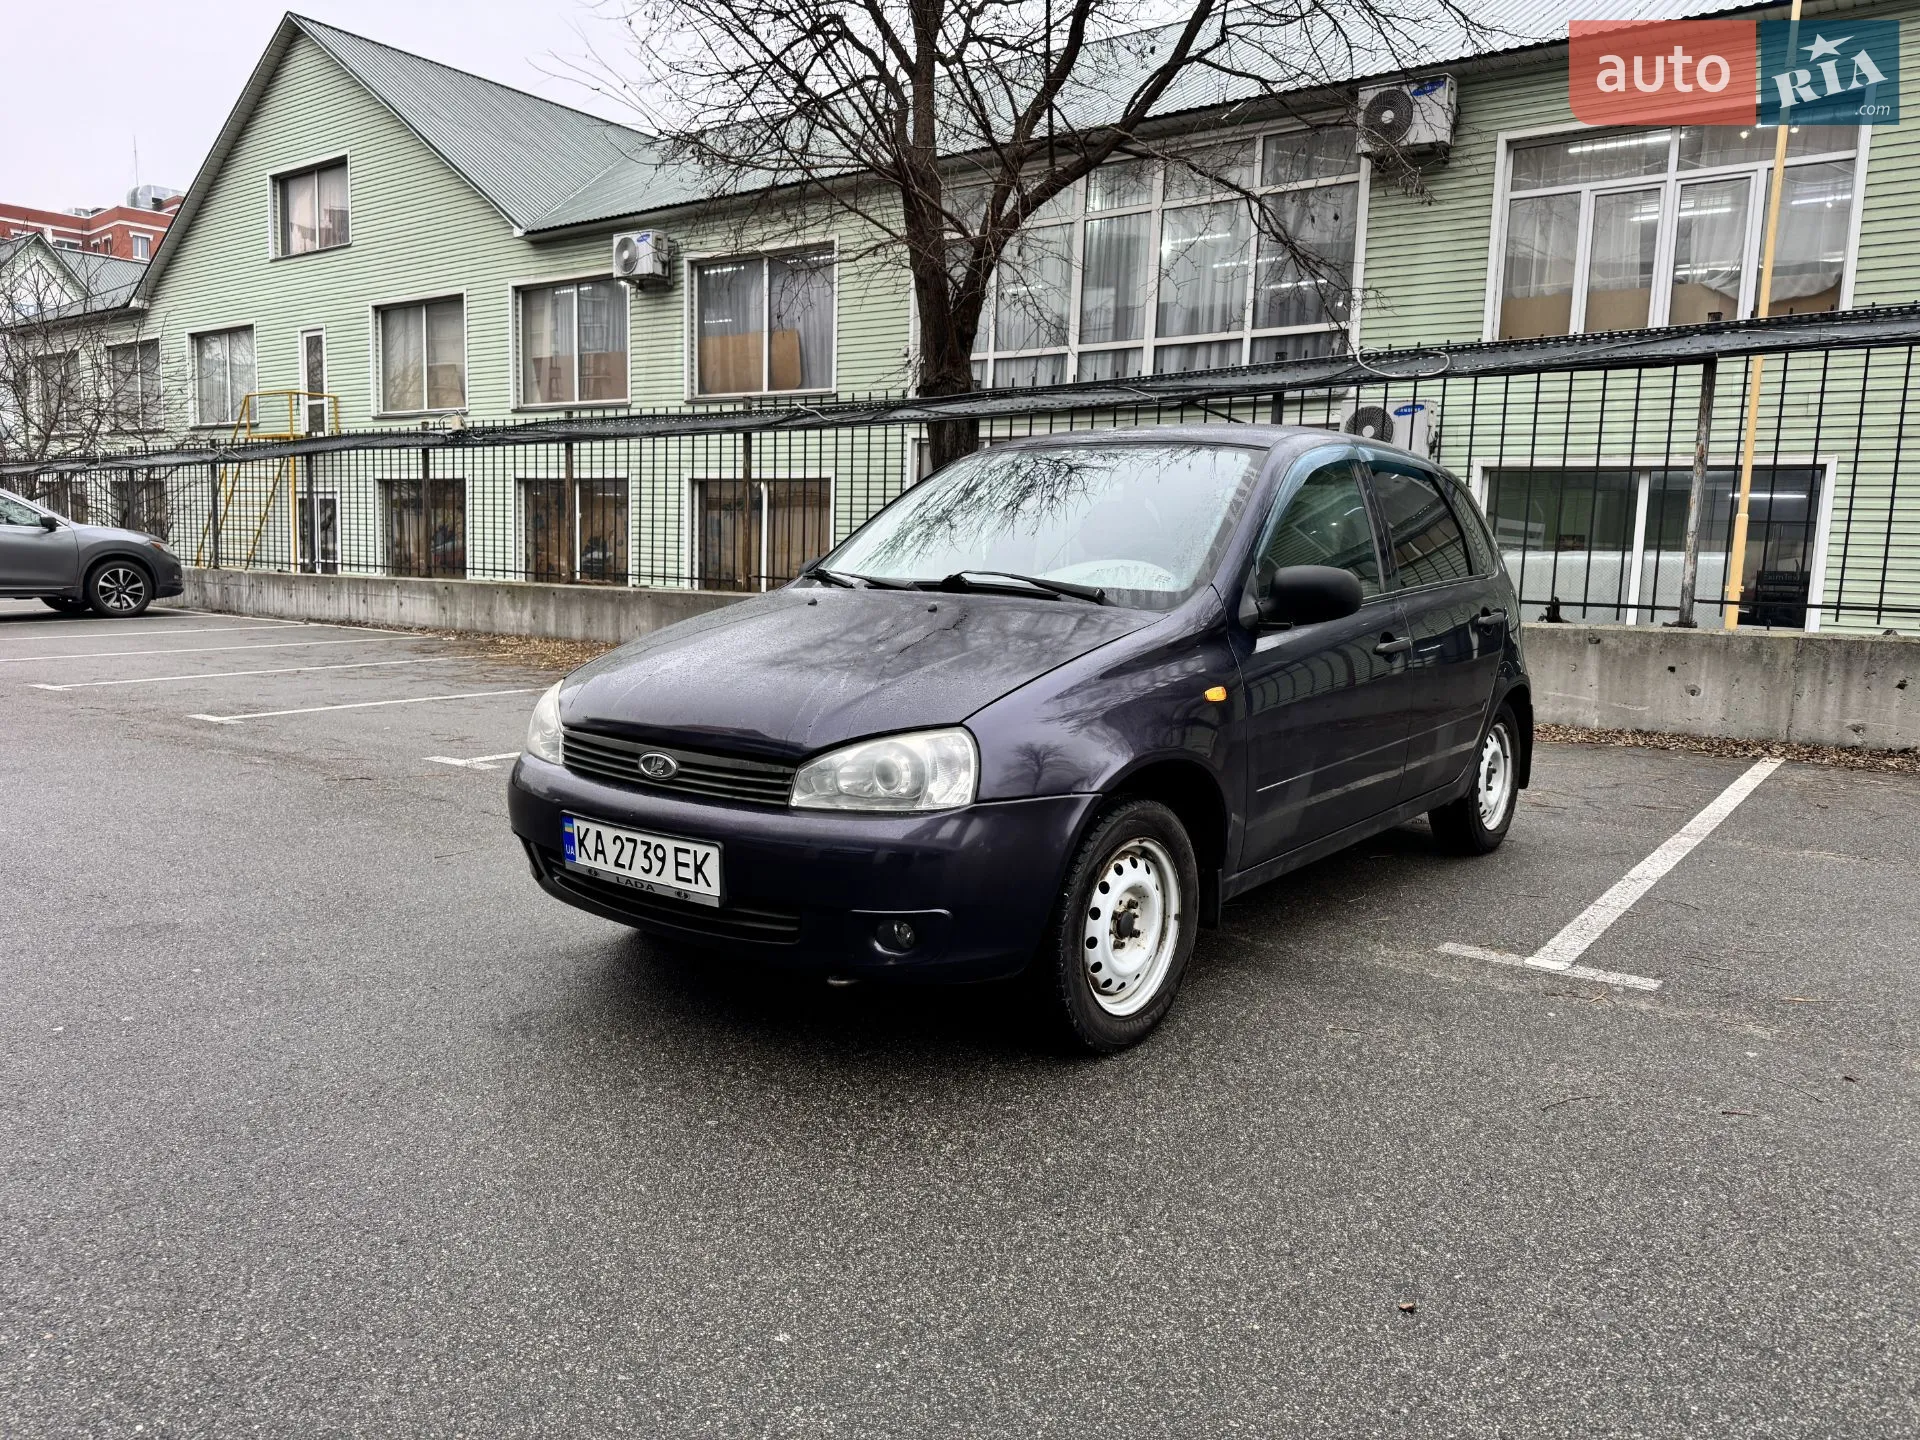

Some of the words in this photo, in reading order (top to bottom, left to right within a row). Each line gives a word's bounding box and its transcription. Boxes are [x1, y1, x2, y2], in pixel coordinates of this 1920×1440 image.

[565, 844, 575, 855] UA
[577, 826, 607, 864] KA
[613, 835, 666, 876] 2739
[674, 847, 711, 887] EK
[616, 876, 655, 892] LADA
